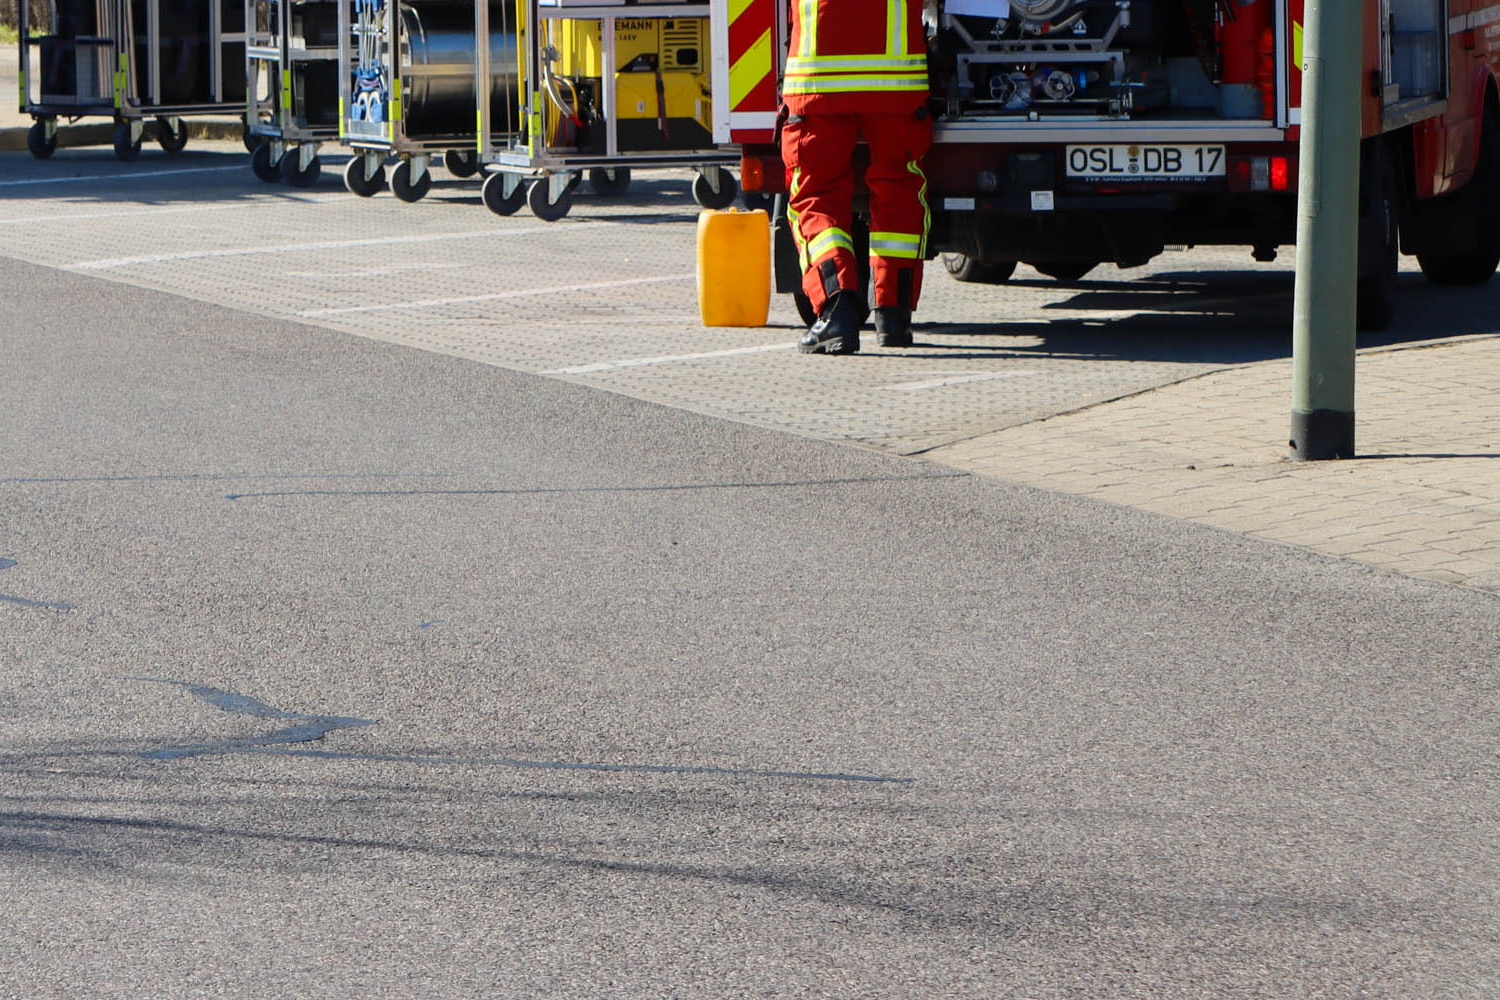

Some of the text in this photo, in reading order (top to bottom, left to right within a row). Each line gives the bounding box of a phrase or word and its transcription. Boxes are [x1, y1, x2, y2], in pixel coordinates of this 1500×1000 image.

[598, 21, 652, 31] EEMANN
[1070, 147, 1223, 173] OSL DB 17
